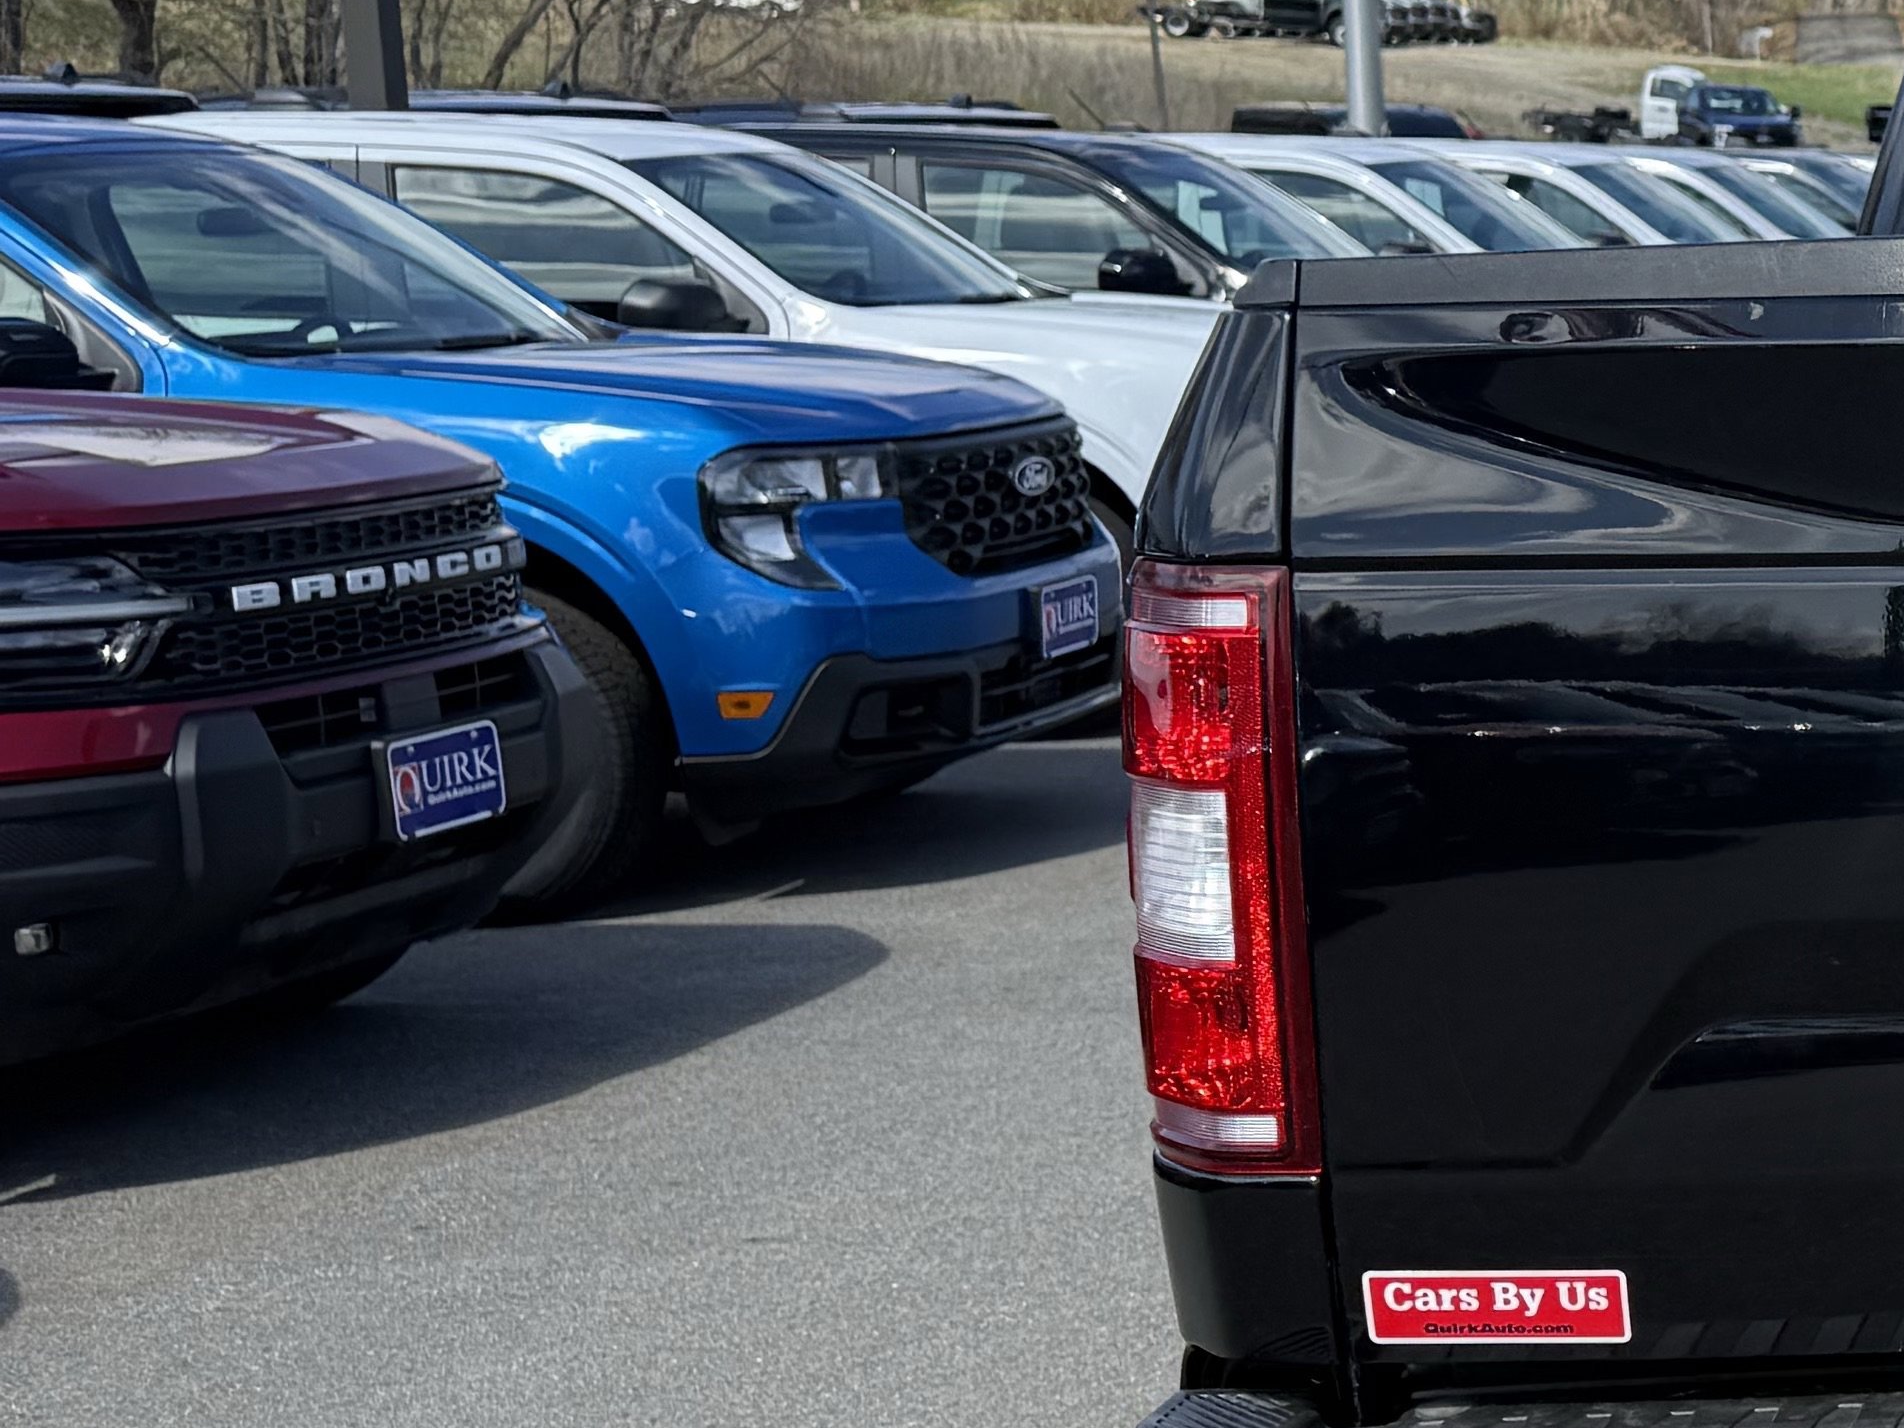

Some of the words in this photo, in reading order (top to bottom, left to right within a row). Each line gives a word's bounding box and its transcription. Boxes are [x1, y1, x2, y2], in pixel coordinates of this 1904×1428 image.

[231, 545, 501, 611] BRONCO
[1045, 593, 1095, 640] QUIRK
[394, 744, 497, 817] QUIRK
[1383, 1282, 1480, 1312] Cars
[1490, 1282, 1545, 1317] By
[1555, 1282, 1609, 1311] Us
[1423, 1323, 1574, 1334] QuirkAuto.com
